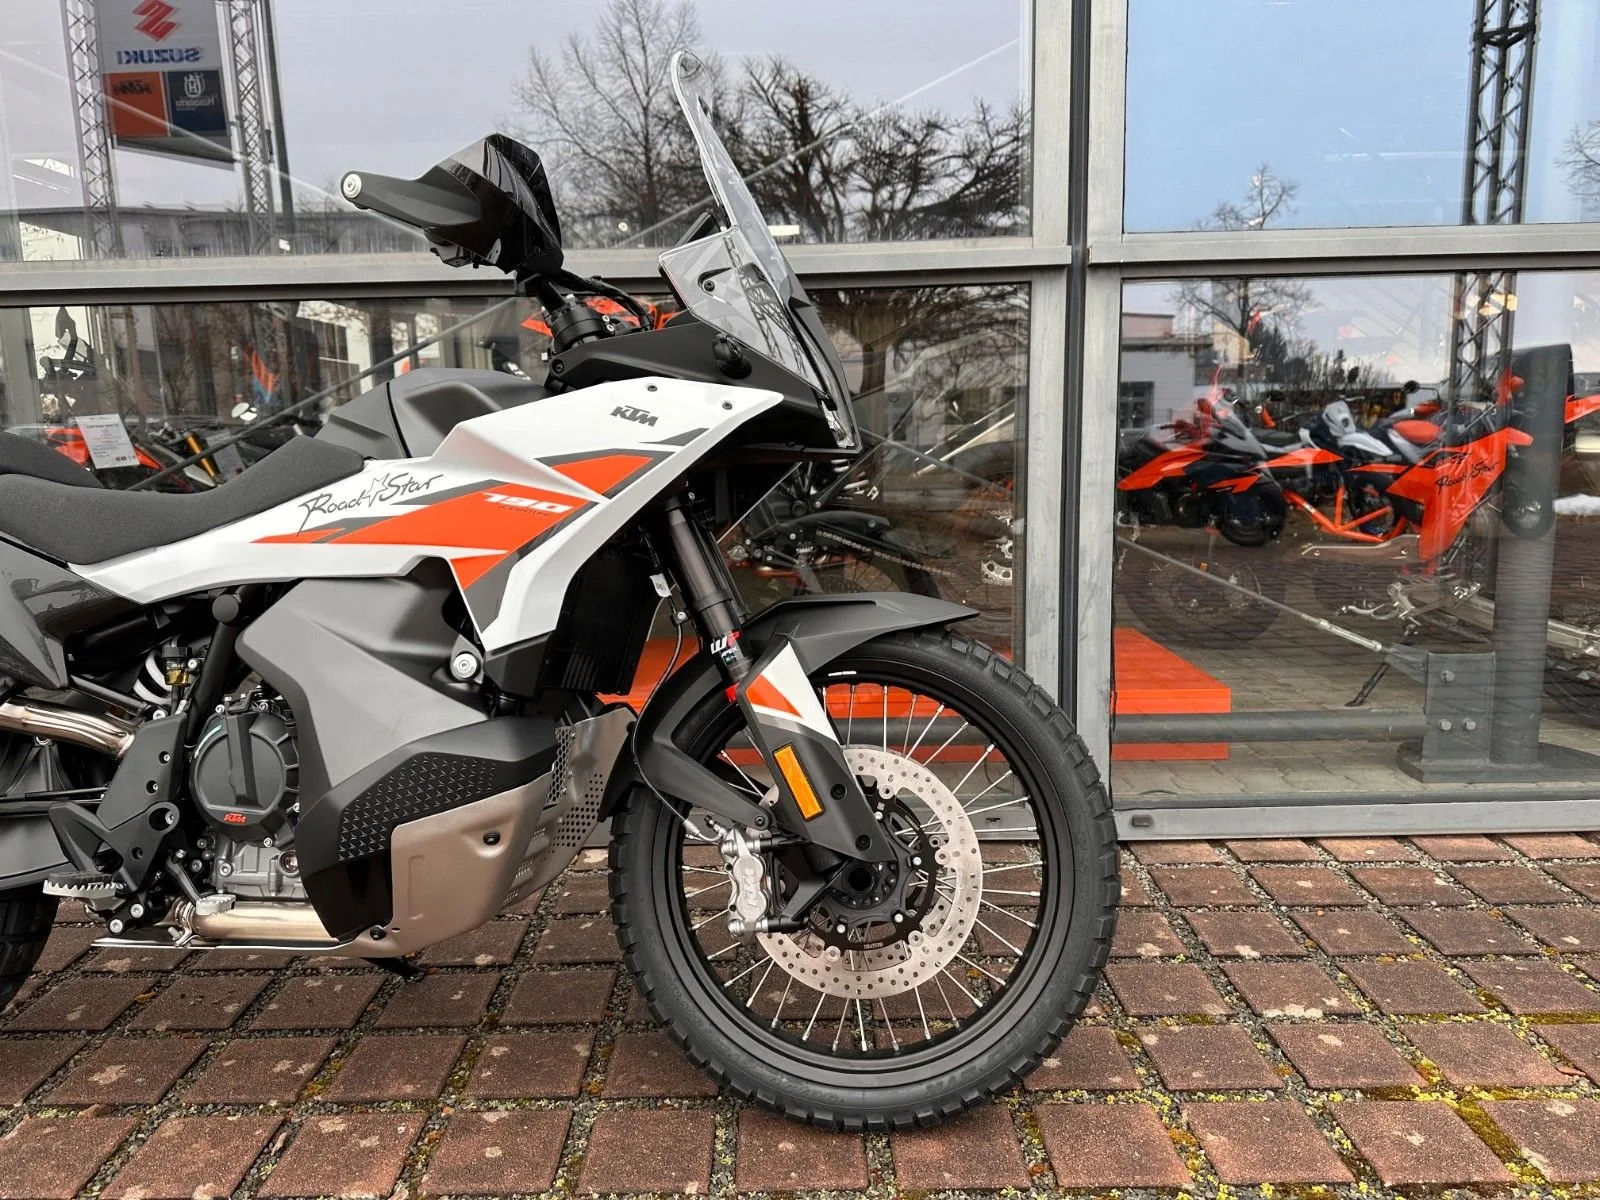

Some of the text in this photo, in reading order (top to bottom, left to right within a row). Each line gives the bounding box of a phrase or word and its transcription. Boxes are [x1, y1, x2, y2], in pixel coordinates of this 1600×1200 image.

[610, 405, 658, 427] KTM
[296, 472, 444, 537] Road Star
[482, 492, 575, 514] 790
[223, 812, 247, 823] KTM
